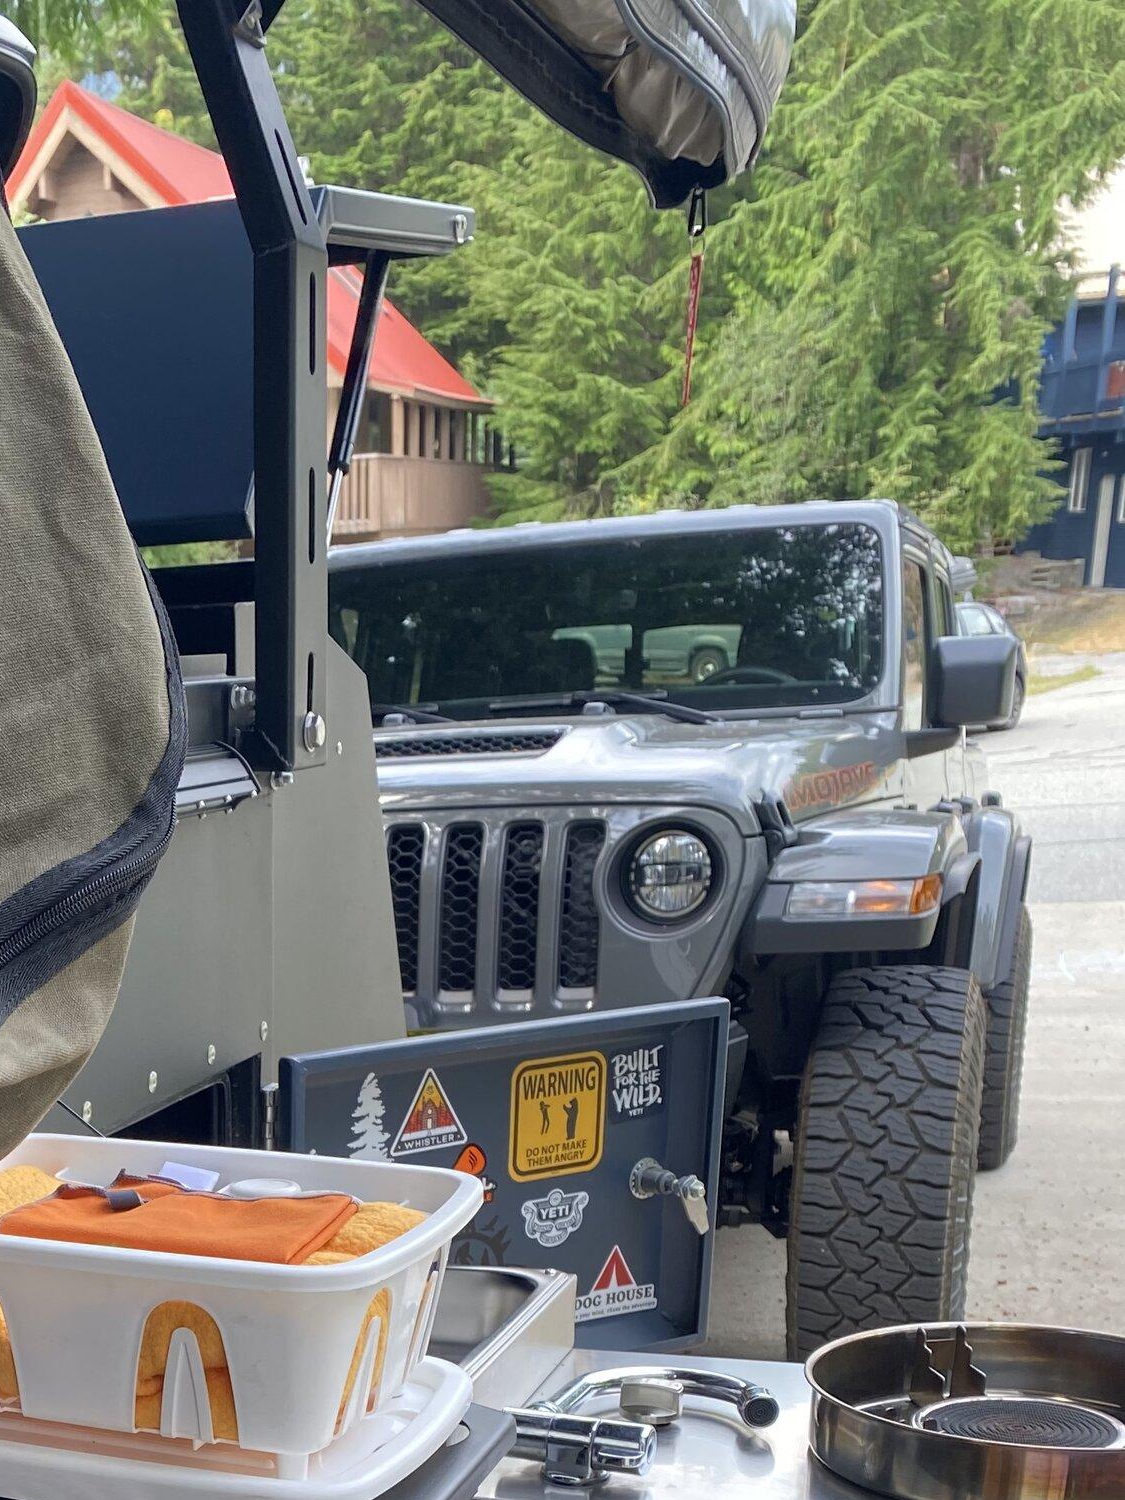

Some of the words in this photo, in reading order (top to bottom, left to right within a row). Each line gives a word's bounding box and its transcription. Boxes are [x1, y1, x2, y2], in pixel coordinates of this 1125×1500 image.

[784, 763, 876, 809] MOJAVE
[611, 1044, 664, 1077] BUILT
[522, 1066, 597, 1101] WARNING
[613, 1072, 638, 1089] FOR
[639, 1068, 661, 1085] THE
[612, 1083, 663, 1113] WILD.
[628, 1107, 644, 1117] YETI
[404, 1133, 455, 1150] WHISTLER
[526, 1147, 540, 1158] DO
[541, 1143, 560, 1155] NOT
[562, 1139, 588, 1151] MAKE
[527, 1156, 553, 1168] THEM
[555, 1150, 585, 1163] ANGRY
[539, 1204, 570, 1220] YETI
[575, 1294, 602, 1311] DOG
[605, 1286, 653, 1306] HOUSE
